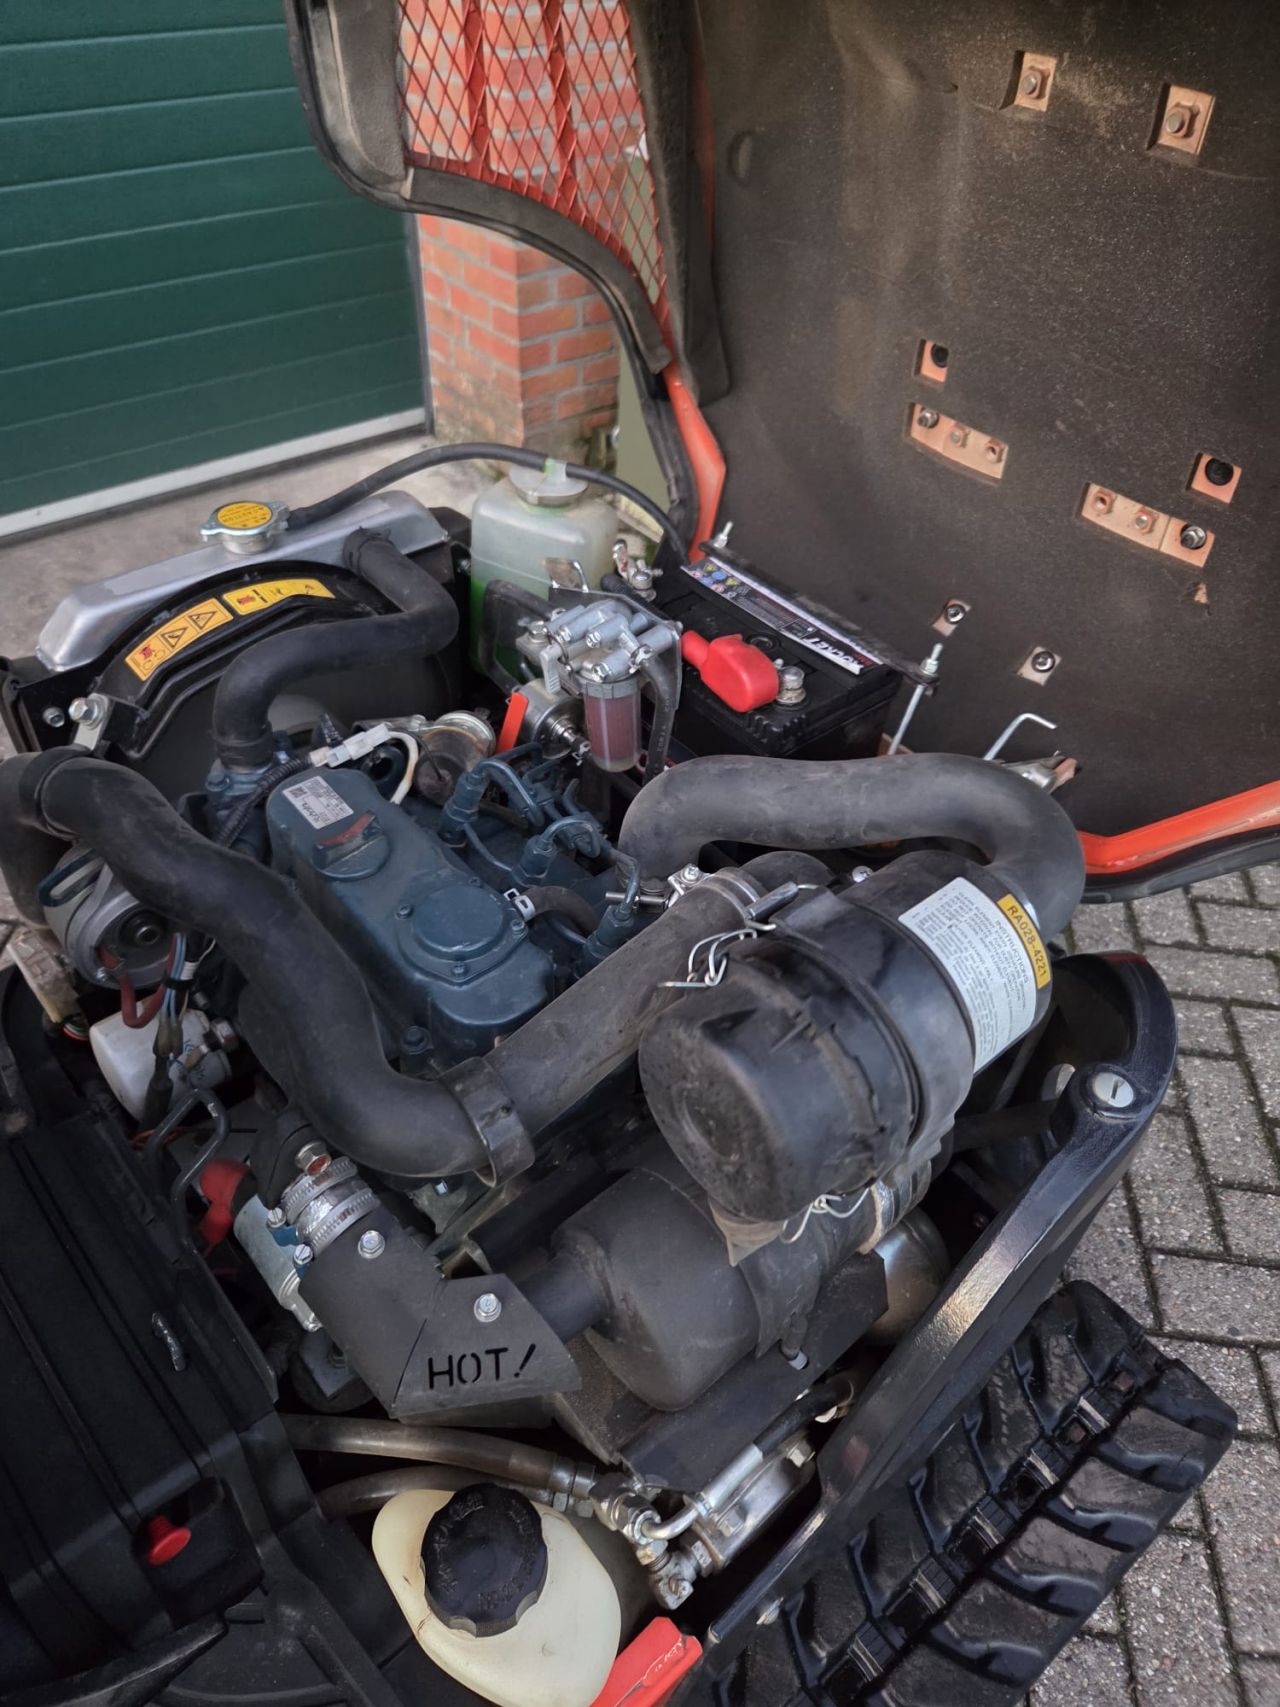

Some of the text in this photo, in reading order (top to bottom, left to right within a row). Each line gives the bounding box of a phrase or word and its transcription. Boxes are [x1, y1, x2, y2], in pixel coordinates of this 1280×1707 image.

[994, 919, 1029, 983] INSTRUCTIONS
[1006, 904, 1046, 976] RA028-4221
[428, 1343, 537, 1389] HOT!
